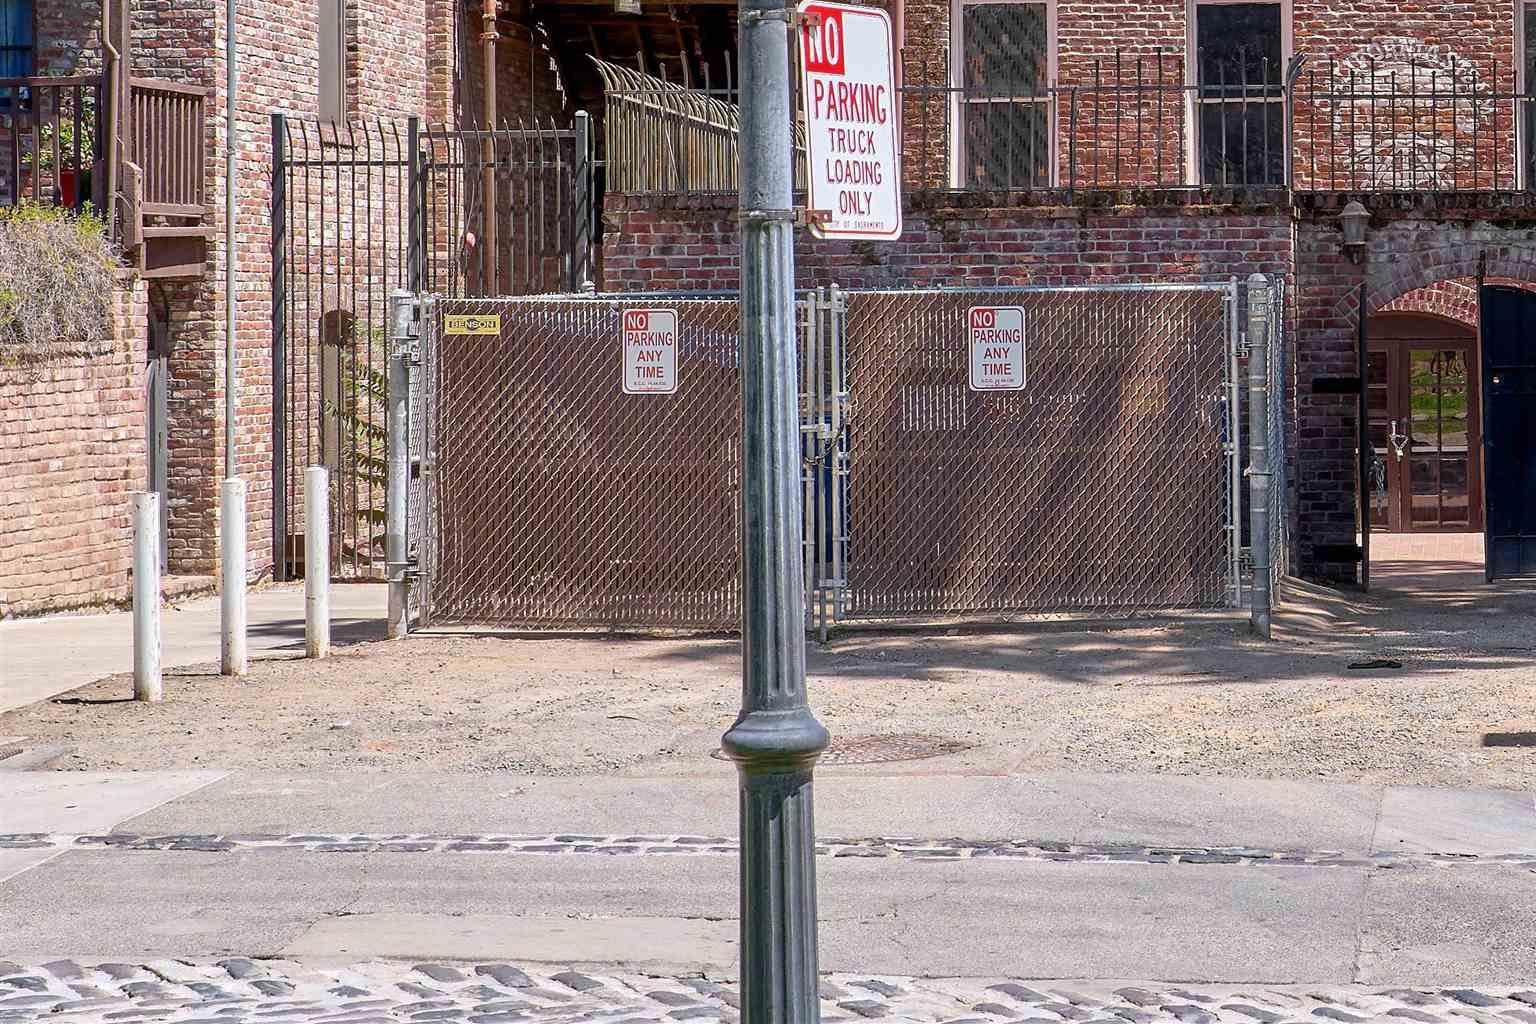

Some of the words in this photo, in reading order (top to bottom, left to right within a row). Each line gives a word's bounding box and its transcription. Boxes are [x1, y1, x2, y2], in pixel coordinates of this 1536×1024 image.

[808, 16, 839, 65] NO
[814, 79, 887, 125] PARKING
[828, 127, 876, 155] TRUCK
[826, 158, 882, 185] LOADING
[839, 190, 873, 215] ONLY
[448, 320, 497, 329] BENSON
[627, 313, 647, 330] NO
[973, 311, 993, 327] NO
[627, 331, 673, 347] PARKING
[973, 328, 1021, 344] PARKING
[637, 350, 663, 362] ANY
[983, 347, 1010, 360] ANY
[635, 366, 664, 378] TIME
[982, 363, 1012, 376] TIME
